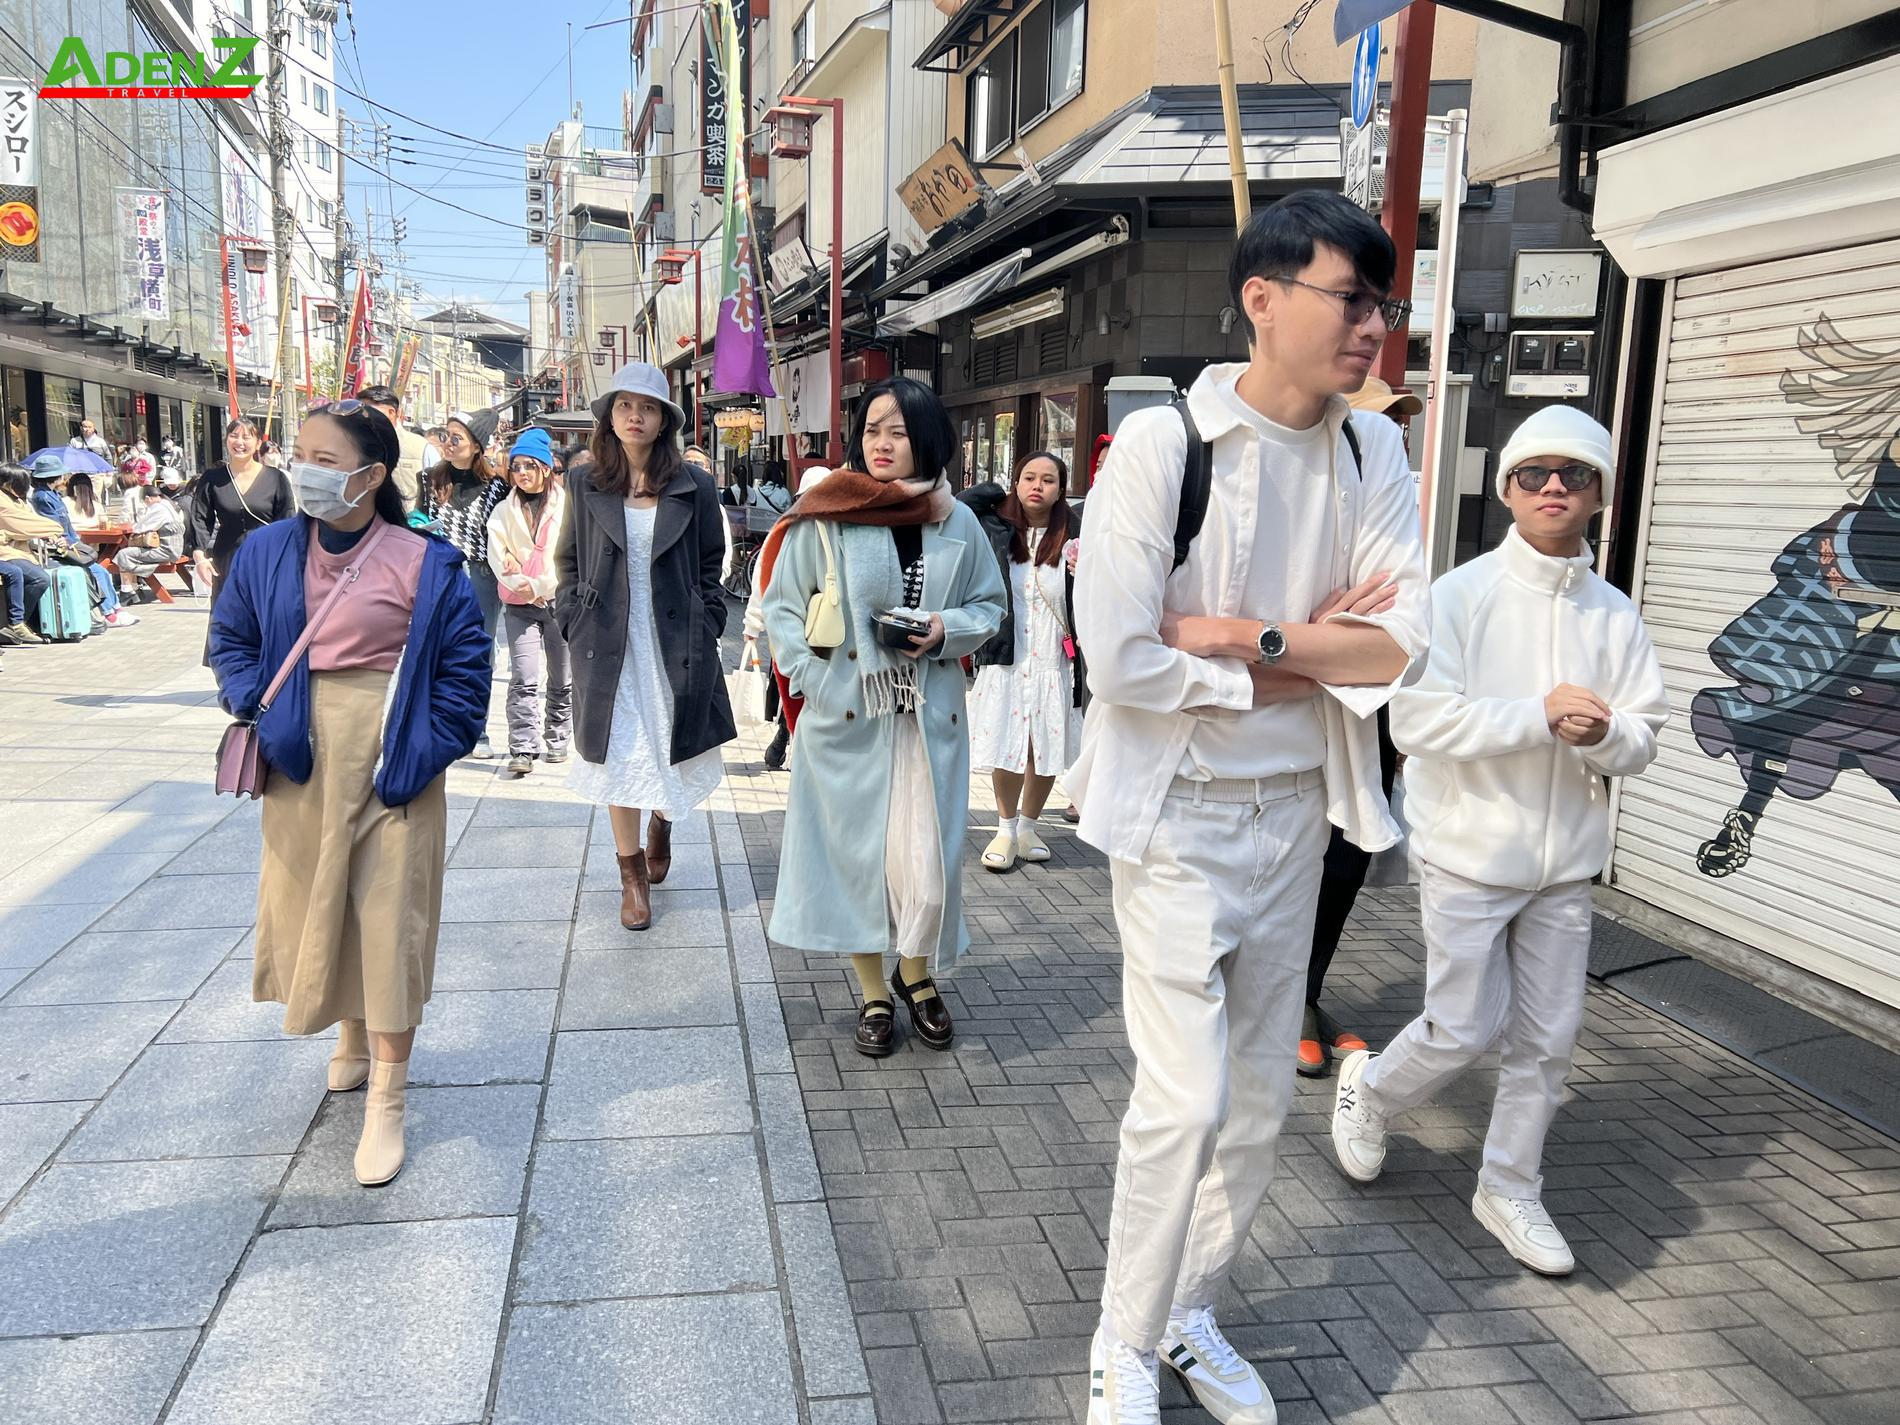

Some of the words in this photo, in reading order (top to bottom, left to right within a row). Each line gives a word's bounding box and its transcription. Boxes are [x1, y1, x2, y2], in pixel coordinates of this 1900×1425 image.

[3, 90, 30, 174] スシロー
[138, 237, 165, 311] 浅草横町
